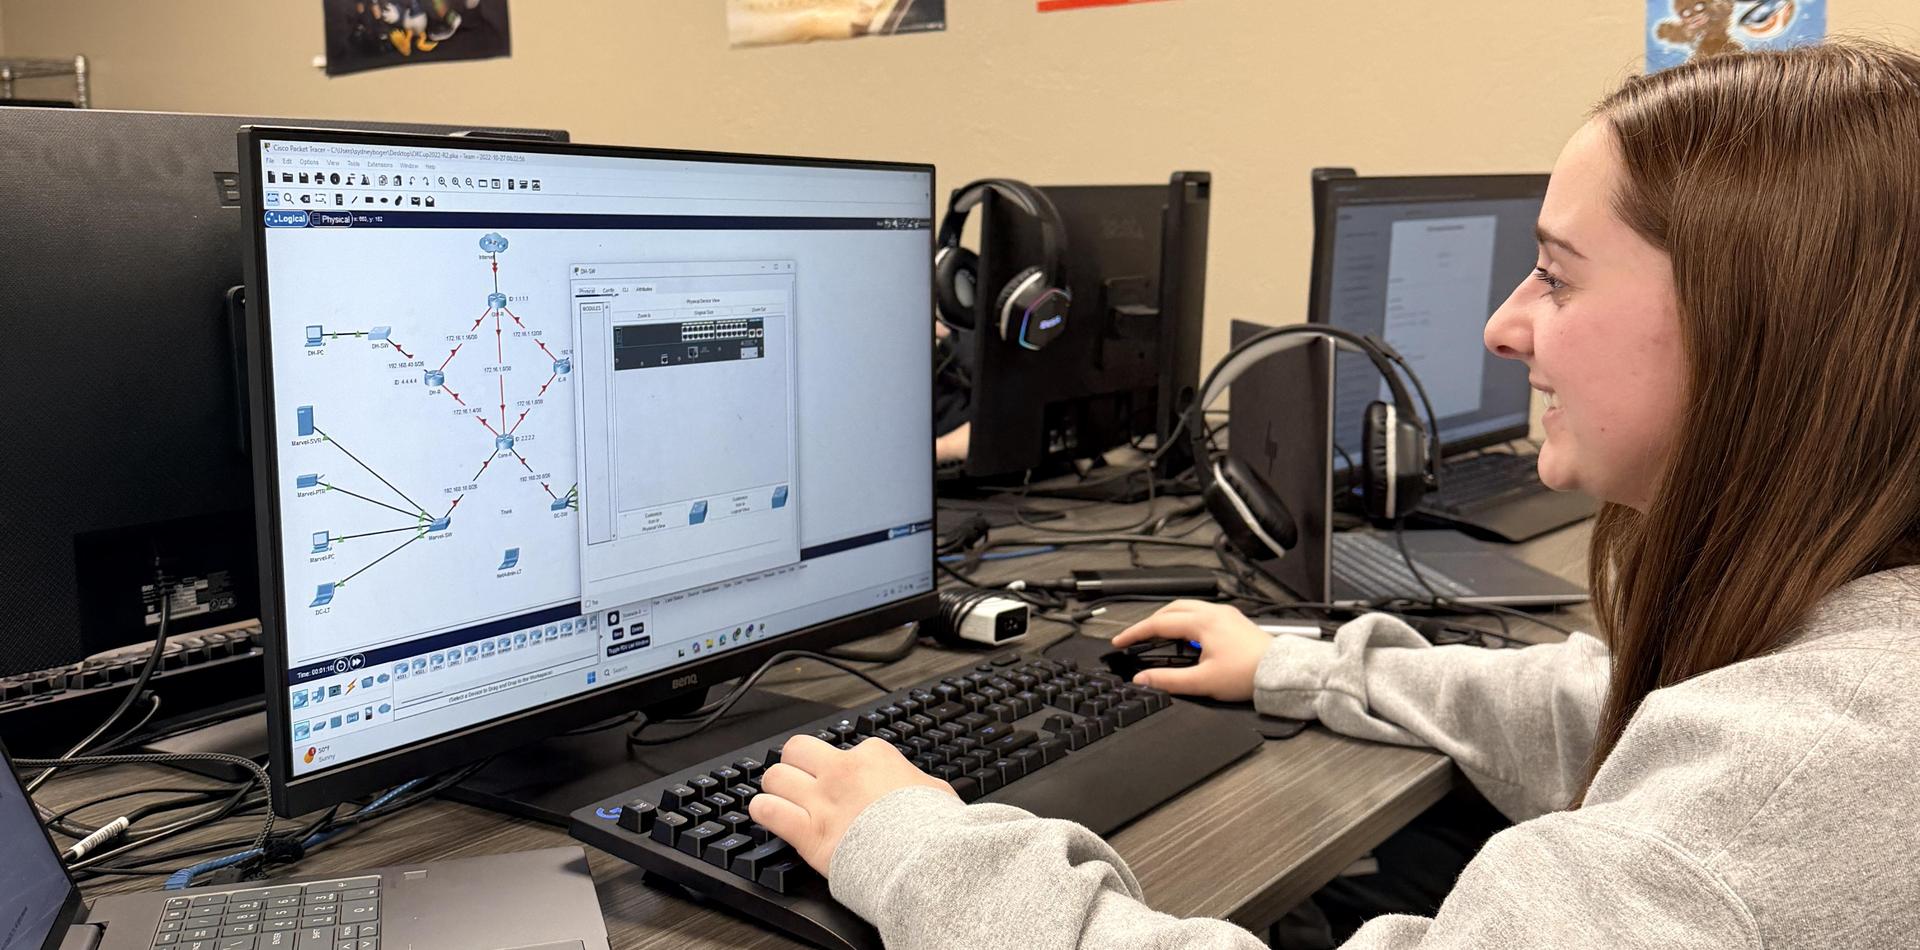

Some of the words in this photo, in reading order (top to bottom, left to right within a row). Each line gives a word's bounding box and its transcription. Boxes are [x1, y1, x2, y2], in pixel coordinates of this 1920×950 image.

[300, 158, 319, 166] Options
[278, 213, 306, 224] Logical
[321, 213, 350, 225] Physical
[297, 671, 311, 679] Time:
